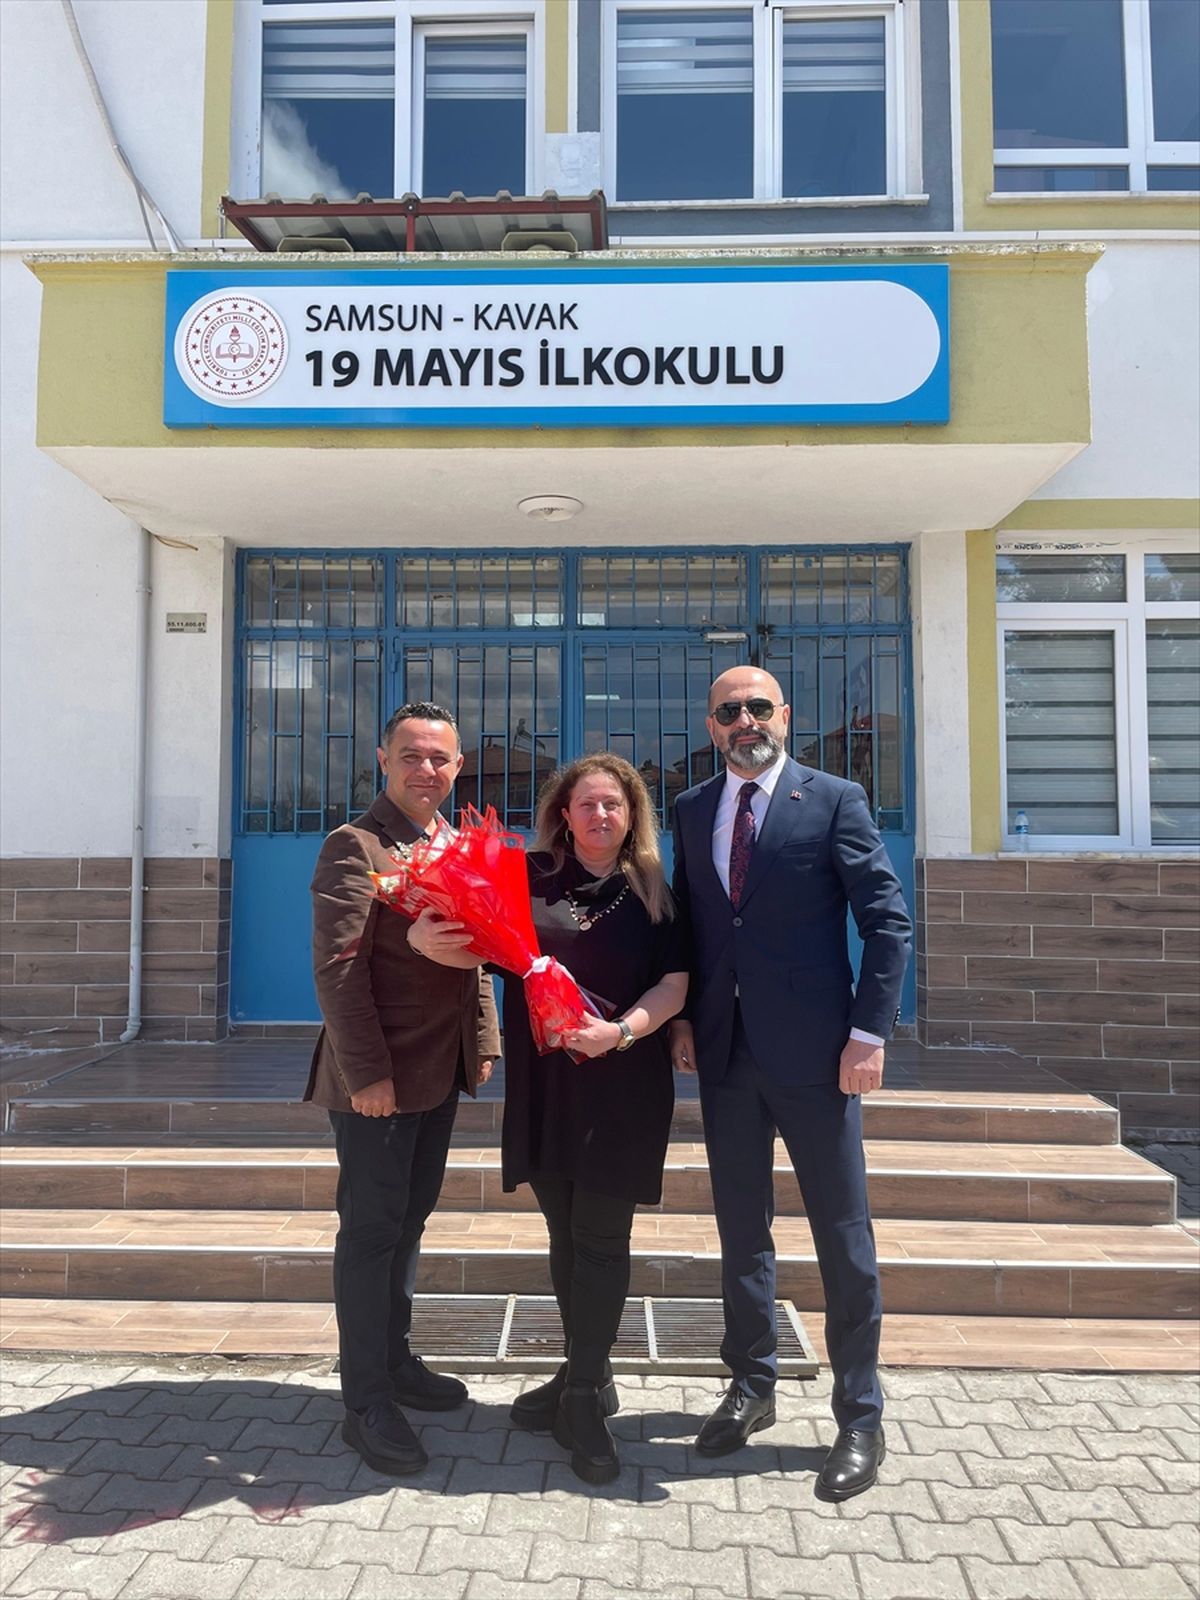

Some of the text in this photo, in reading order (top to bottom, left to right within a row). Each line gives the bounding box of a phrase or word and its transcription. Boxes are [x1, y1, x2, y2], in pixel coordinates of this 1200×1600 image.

[305, 303, 443, 332] SAMSUN
[474, 303, 579, 331] KAVAK
[305, 338, 784, 388] 19 MAYIS İLKOKULU
